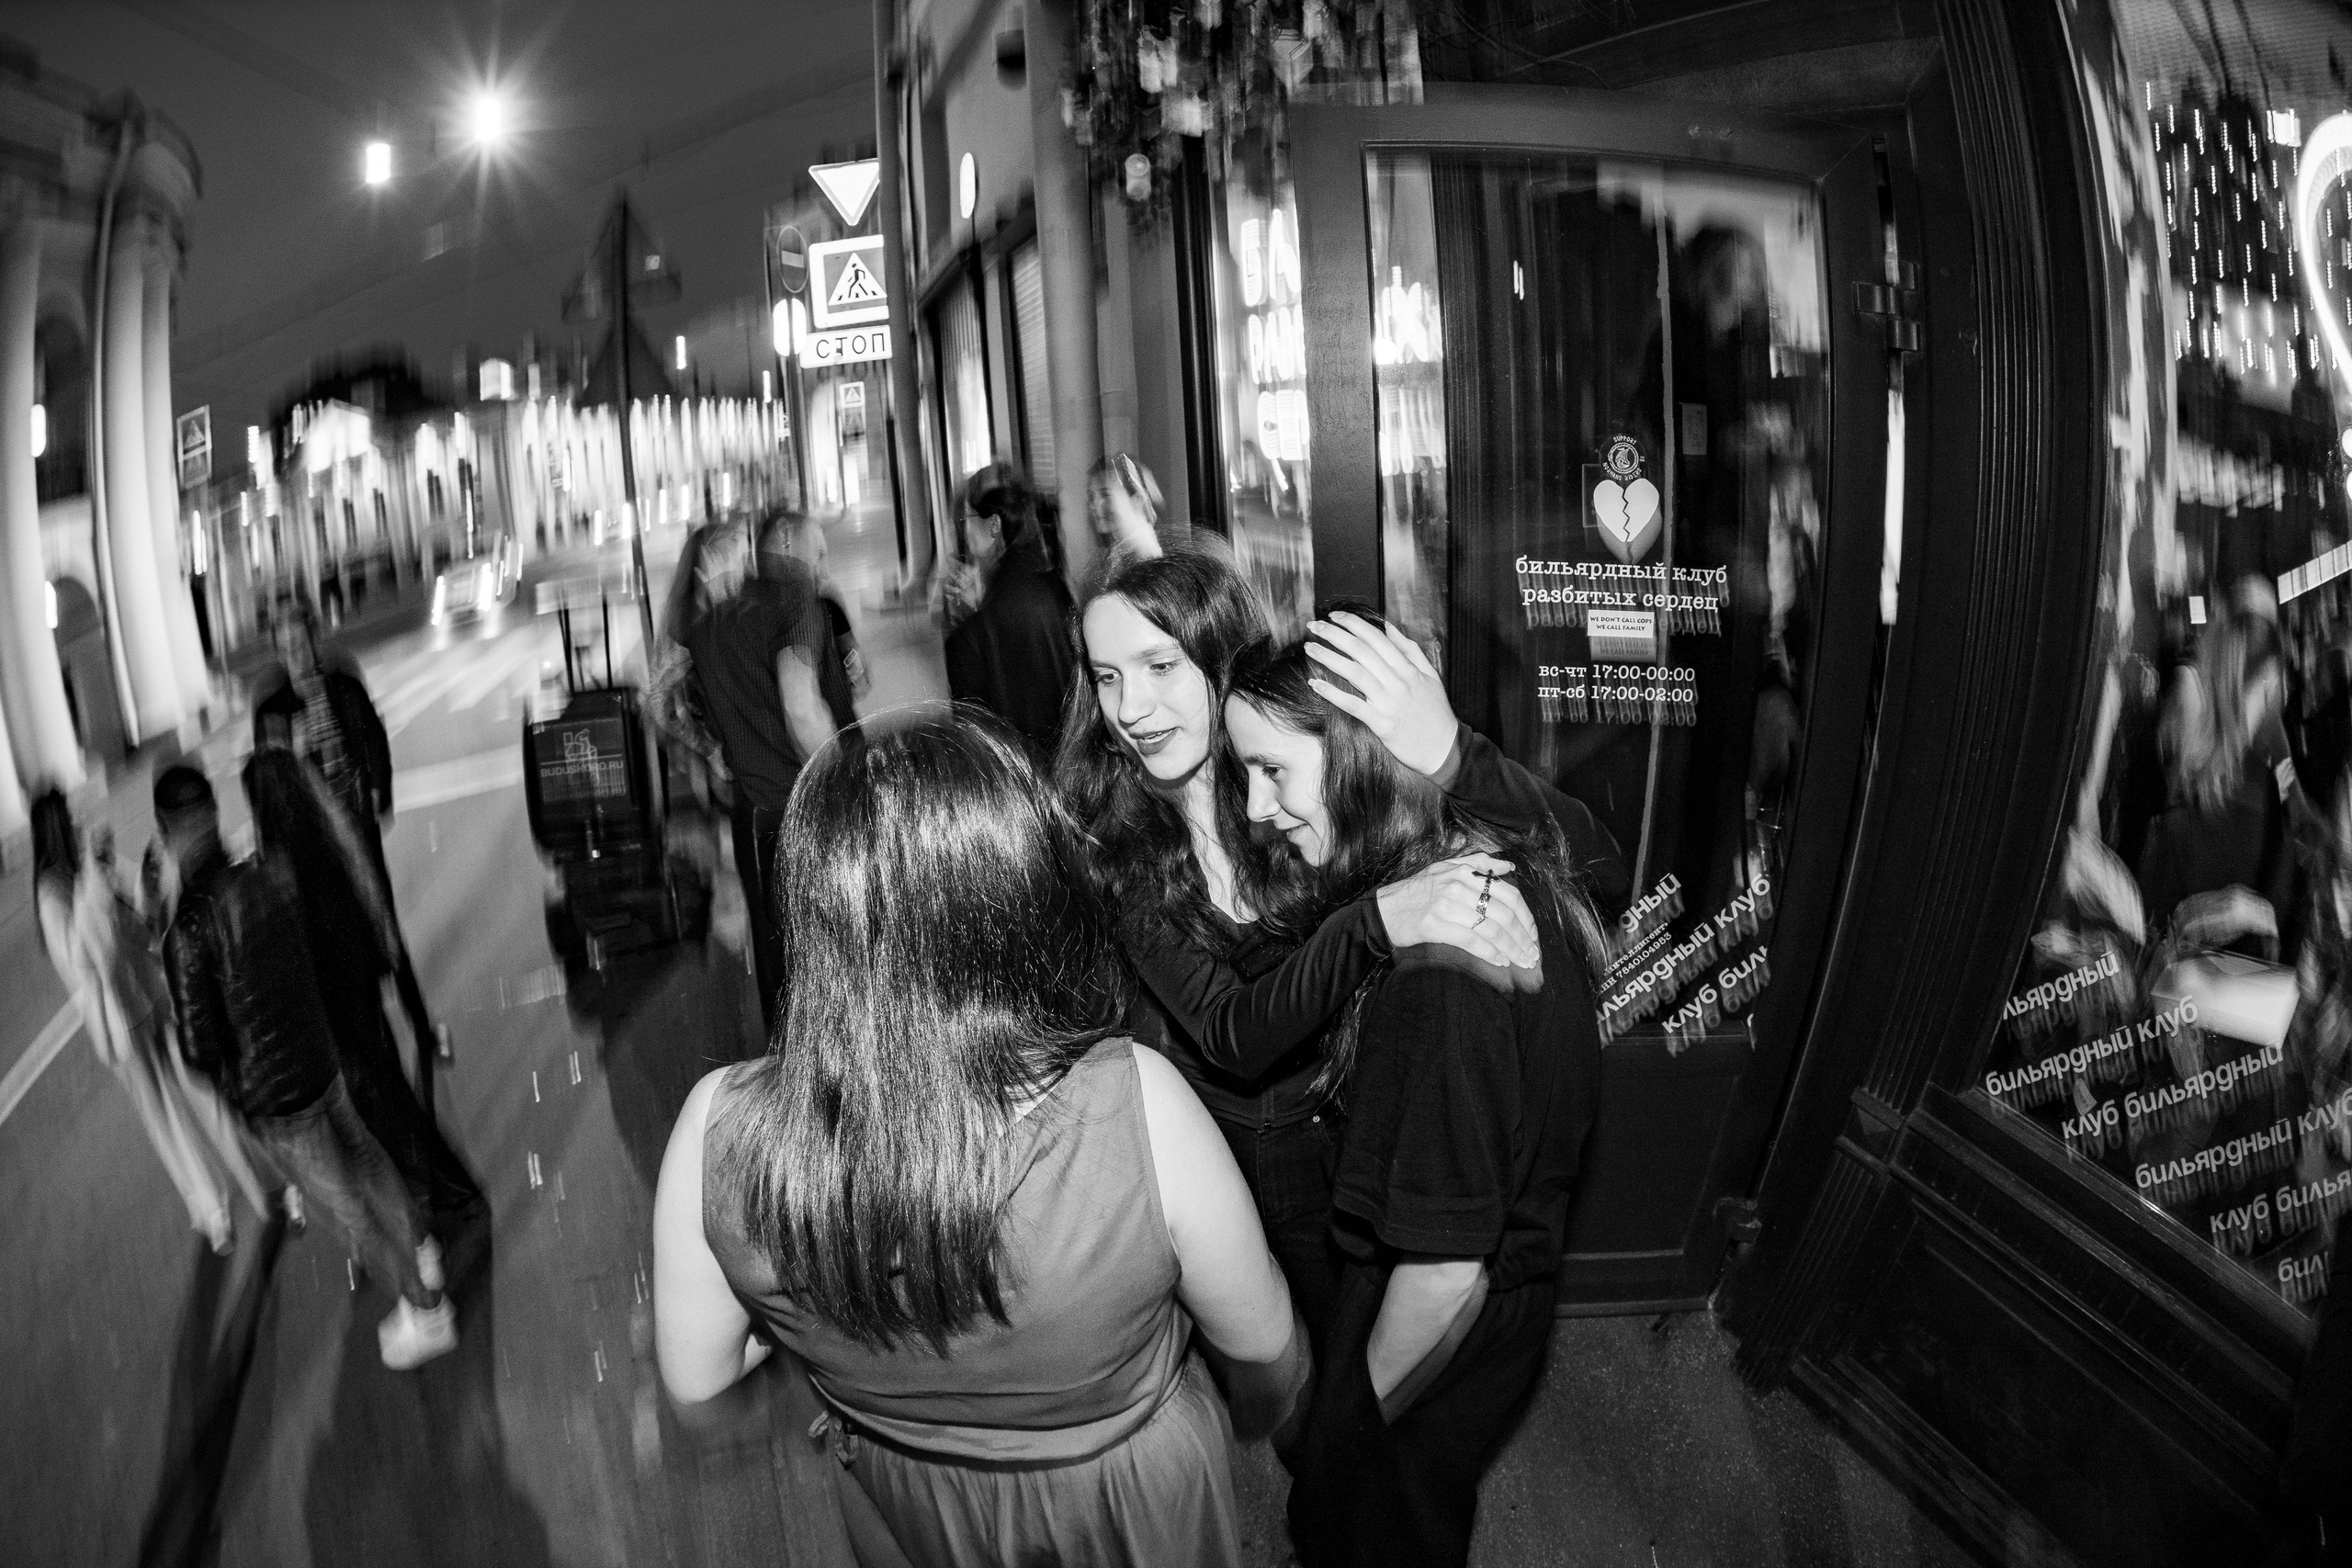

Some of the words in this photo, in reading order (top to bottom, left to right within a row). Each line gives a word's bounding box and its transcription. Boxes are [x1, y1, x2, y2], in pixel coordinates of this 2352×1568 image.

[816, 333, 885, 359] СТОП
[1612, 434, 1637, 446] SUPPORT
[1602, 461, 1623, 481] NORMANS
[1624, 467, 1643, 481] RIDERS
[1516, 555, 1667, 581] бильярдный
[1672, 565, 1727, 585] клуб
[1521, 585, 1636, 606] разбитых
[1643, 591, 1718, 613] сердец
[1538, 664, 1587, 679] вс-чт
[1591, 664, 1695, 682] 17:00-00:00
[1538, 684, 1586, 699] пт-сб
[1590, 684, 1693, 703] 17:00-02:00
[1713, 873, 1770, 930] клуб
[1615, 931, 1672, 979] 7840104953
[1661, 983, 1717, 1034] клуб
[1984, 1024, 2134, 1096] бильярдный
[2135, 994, 2199, 1043] клуб
[2061, 1099, 2120, 1139] клуб
[2123, 1039, 2284, 1119] бильярдный
[2134, 1117, 2293, 1189] бильярдный
[2209, 1193, 2270, 1234] клуб
[2275, 1168, 2352, 1213] билья
[2278, 1251, 2329, 1282] бил
